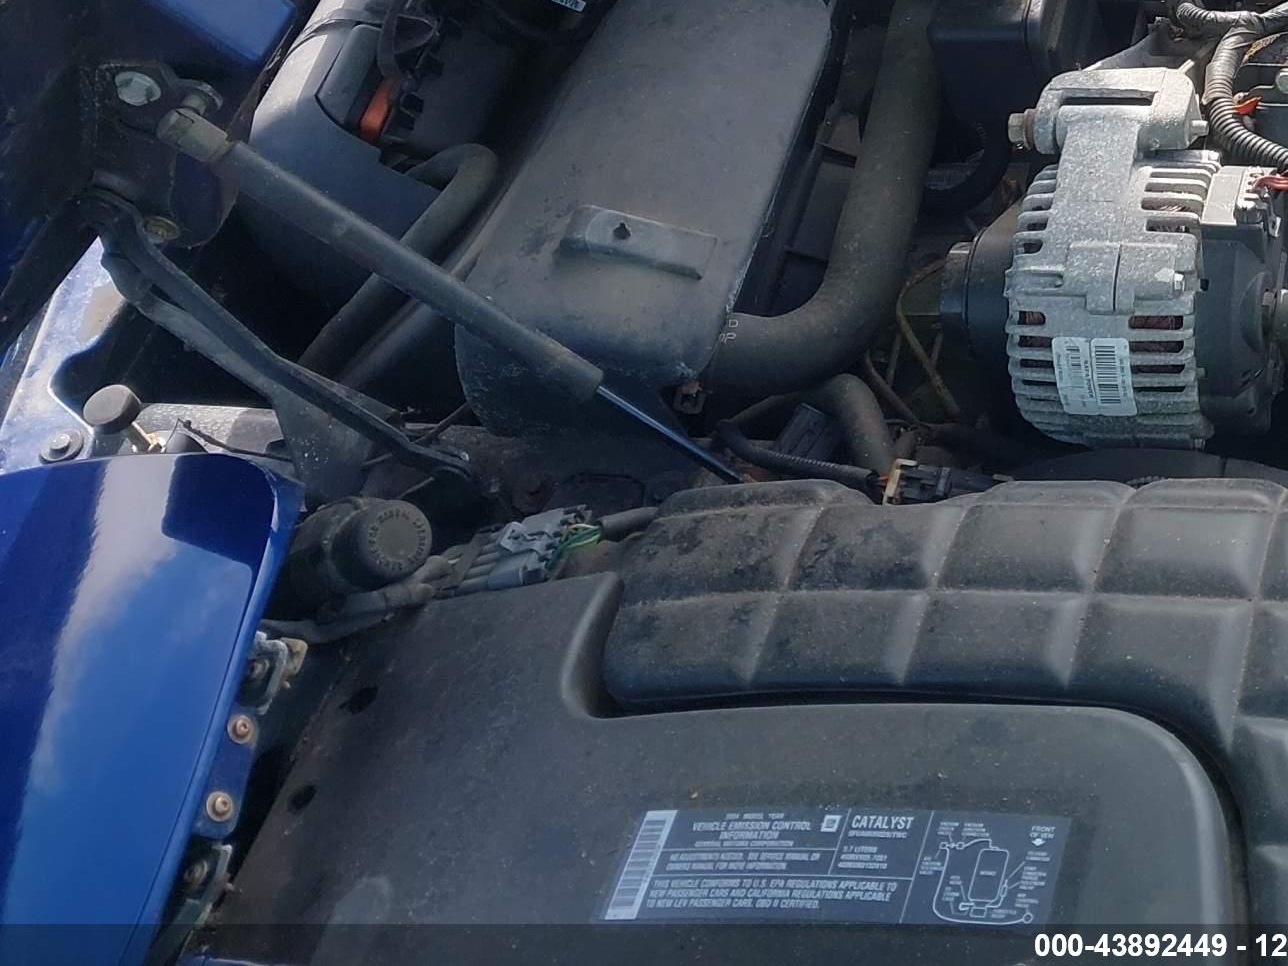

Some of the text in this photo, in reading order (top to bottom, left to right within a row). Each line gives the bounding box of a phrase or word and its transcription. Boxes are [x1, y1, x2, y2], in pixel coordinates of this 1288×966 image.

[693, 821, 727, 831] VEHICLE
[728, 821, 770, 831] EMISSION
[771, 821, 812, 831] CONTROL
[851, 814, 915, 830] CATALYST
[1031, 825, 1057, 833] FRONT
[719, 831, 780, 840] INFORMATION
[653, 879, 670, 888] THIS
[670, 879, 699, 888] VEHICLE
[741, 879, 752, 888] TO
[769, 879, 785, 889] EPA
[785, 879, 837, 890] REGULATIONS
[837, 881, 886, 891] APPLICABLE
[886, 882, 897, 892] TO
[708, 889, 729, 898] CARS
[728, 889, 747, 897] AND
[746, 888, 790, 898] CALIFORNIA
[791, 890, 844, 900] REGULATIONS
[844, 891, 891, 902] APPLICABLE
[688, 899, 732, 908] PASSENGER
